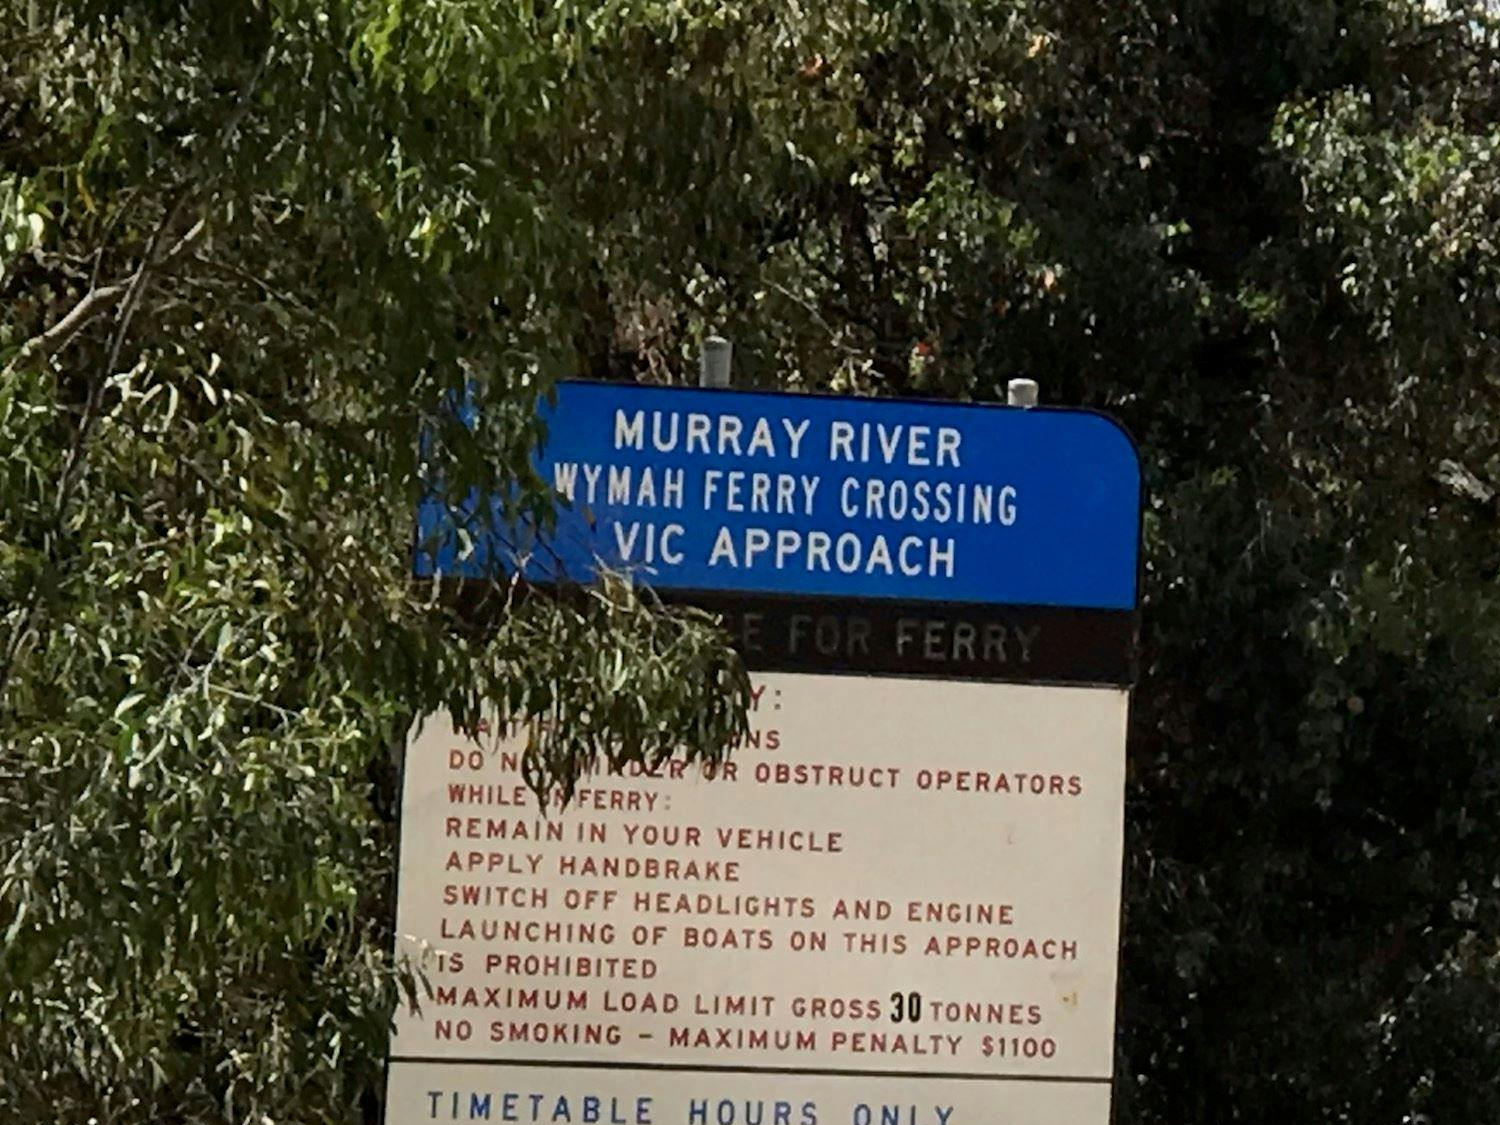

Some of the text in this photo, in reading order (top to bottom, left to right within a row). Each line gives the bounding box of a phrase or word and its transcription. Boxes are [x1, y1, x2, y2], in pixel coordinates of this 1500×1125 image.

[615, 408, 962, 467] MURRAY RIVER
[554, 462, 1017, 526] WYMAH FERRY CROSSING
[614, 521, 955, 578] VIC APPROACH
[790, 613, 871, 655] FOR
[896, 618, 1041, 663] FERRY
[449, 749, 484, 770] DO
[755, 762, 900, 788] OBSTRUCT
[917, 769, 1083, 796] OPERATORS
[448, 784, 526, 806] WHILE
[446, 817, 843, 852] REMAIN IN YOUR VEHICLE
[445, 851, 740, 882] APPLY HANDBRAKE
[443, 885, 1014, 926] SWITCH OFF HEADLIGHTS AND ENGINE
[440, 918, 1078, 960] LAUNCHING OF BOATS ON THIS APPROACH
[438, 953, 658, 980] IS PROHIBITED
[435, 986, 1042, 1026] MAXIMUM LOAD LIMIT GROSS 30 TONNES
[435, 1020, 473, 1042] NO
[489, 1021, 622, 1046] SMOKING
[669, 1026, 816, 1051] MAXIMUM
[831, 1032, 963, 1055] PENALTY
[982, 1037, 1057, 1059] $1100
